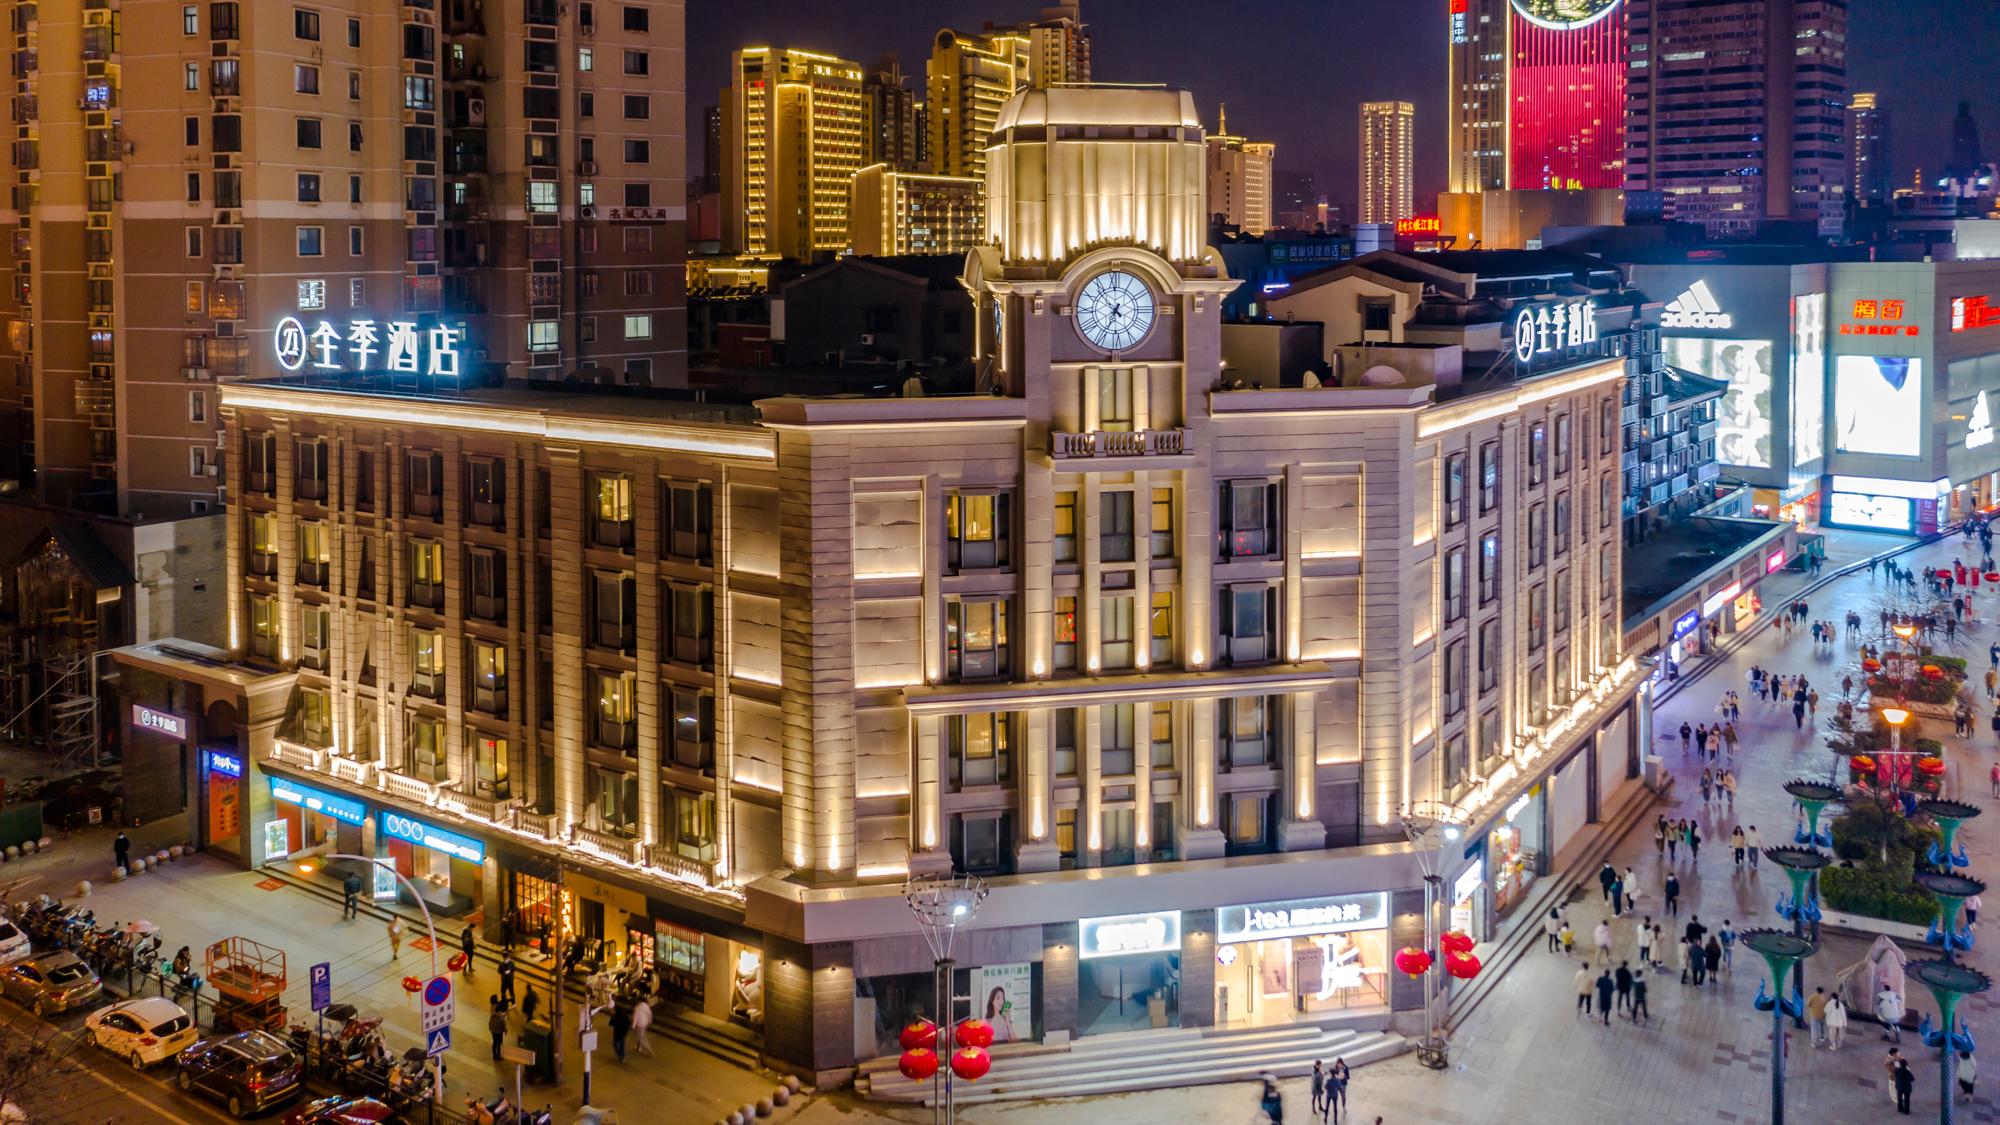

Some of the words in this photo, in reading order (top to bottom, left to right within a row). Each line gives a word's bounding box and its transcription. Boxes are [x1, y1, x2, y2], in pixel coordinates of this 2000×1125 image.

[1535, 300, 1597, 353] 全季酒店
[1660, 312, 1732, 329] adidas
[1853, 299, 1905, 320] 腾百
[312, 319, 462, 376] 全季酒店
